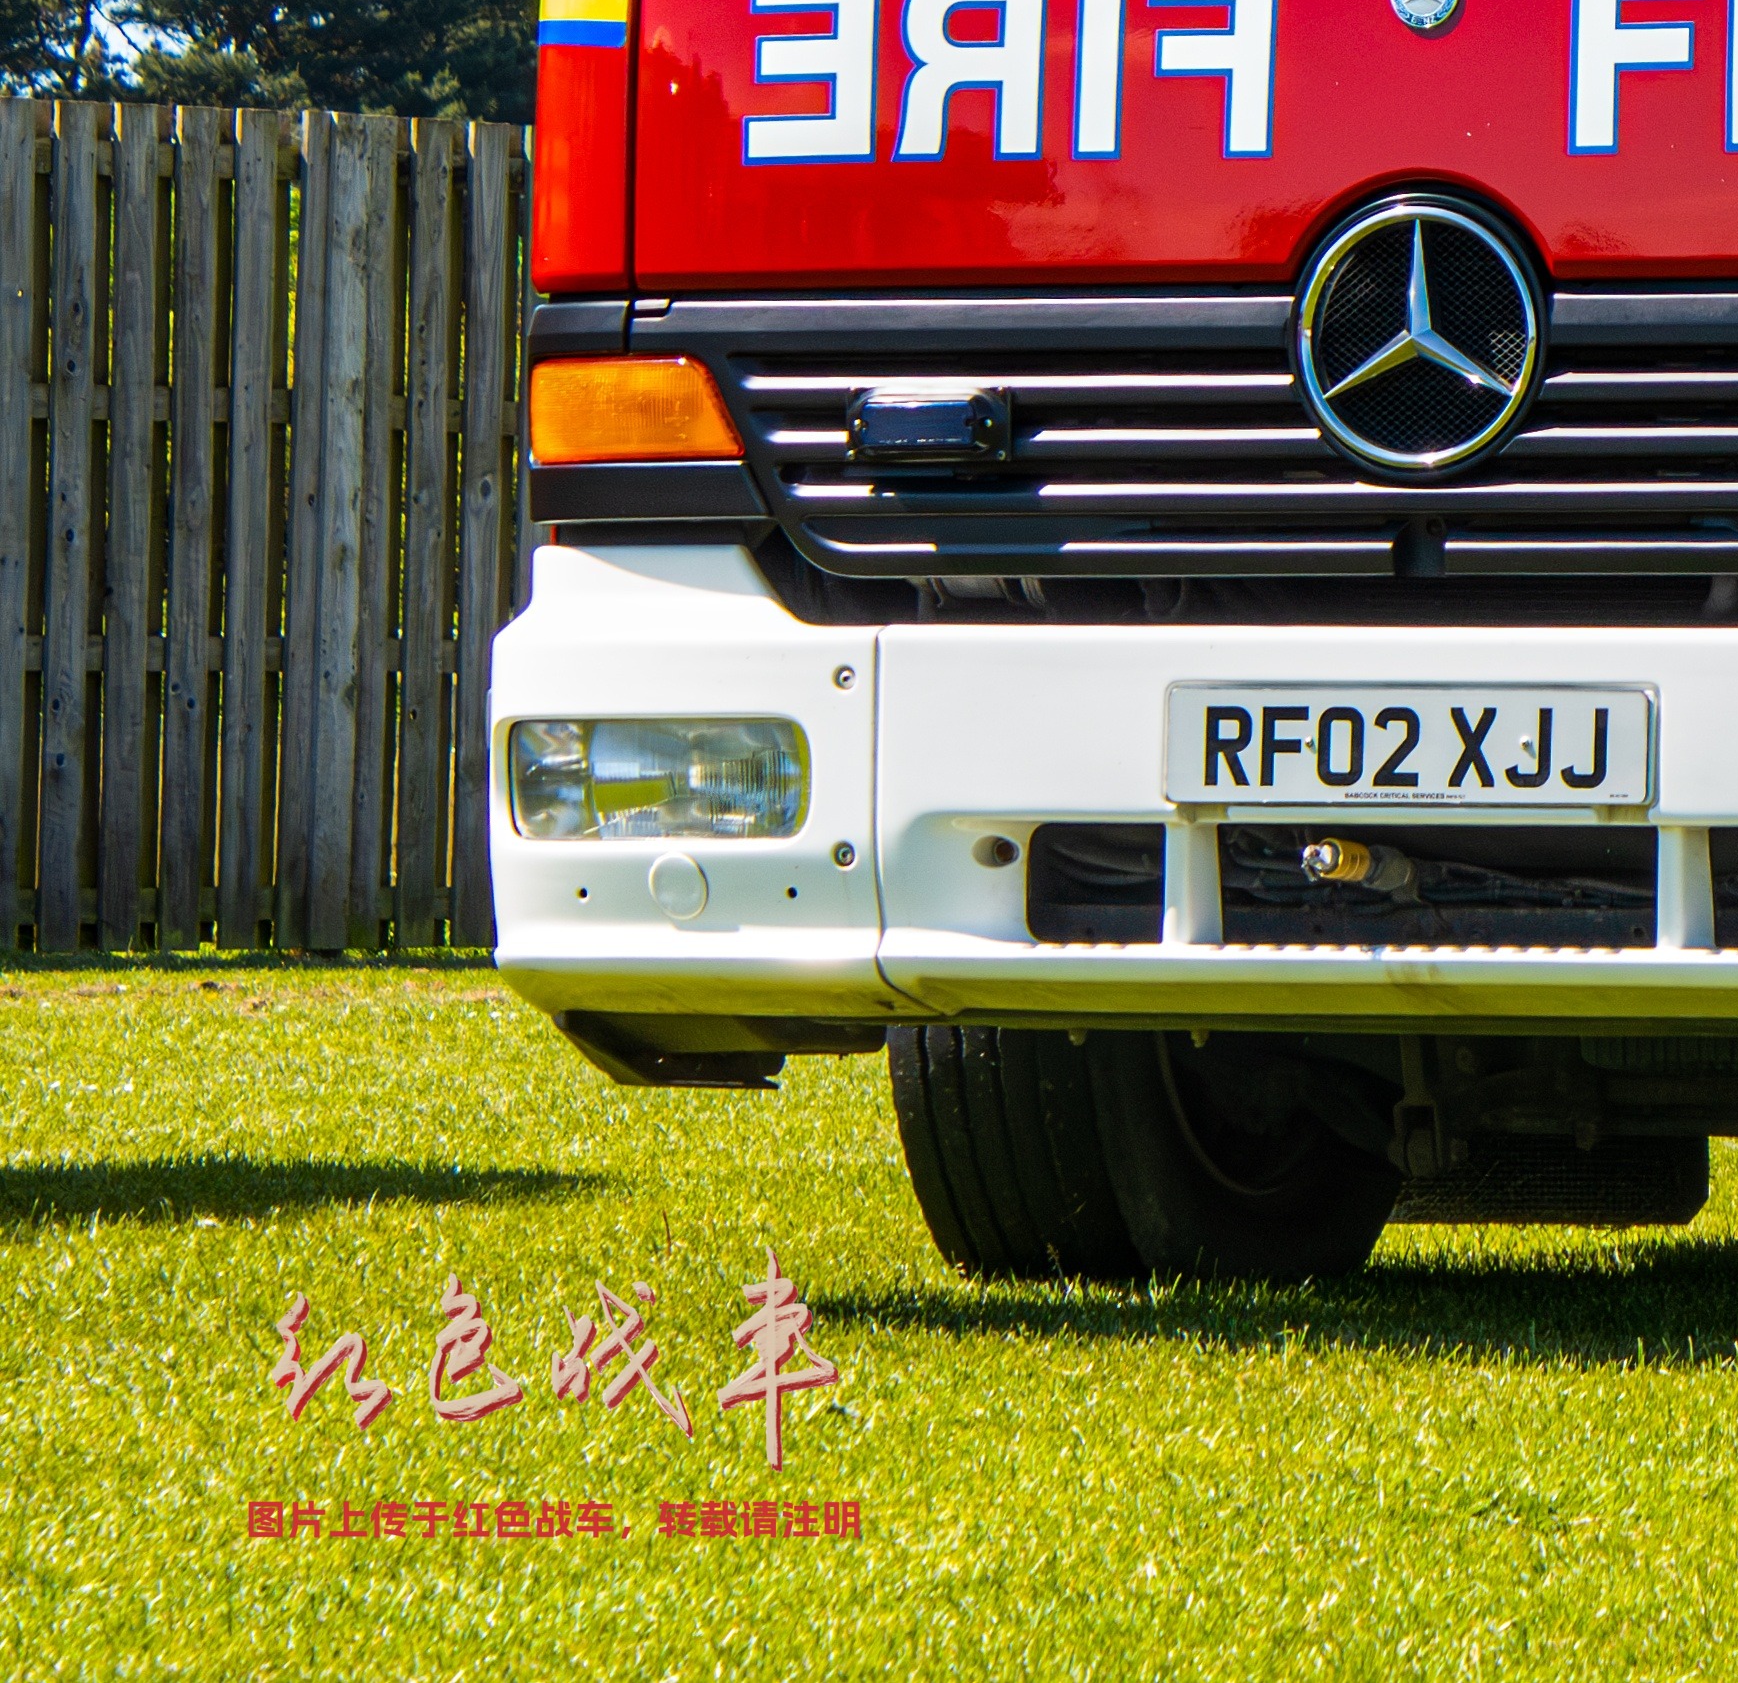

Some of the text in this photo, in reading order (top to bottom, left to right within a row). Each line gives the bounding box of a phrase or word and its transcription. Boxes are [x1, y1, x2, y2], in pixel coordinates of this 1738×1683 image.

[1203, 706, 1610, 789] RF02 XJJ
[1379, 792, 1409, 800] CRITICAL
